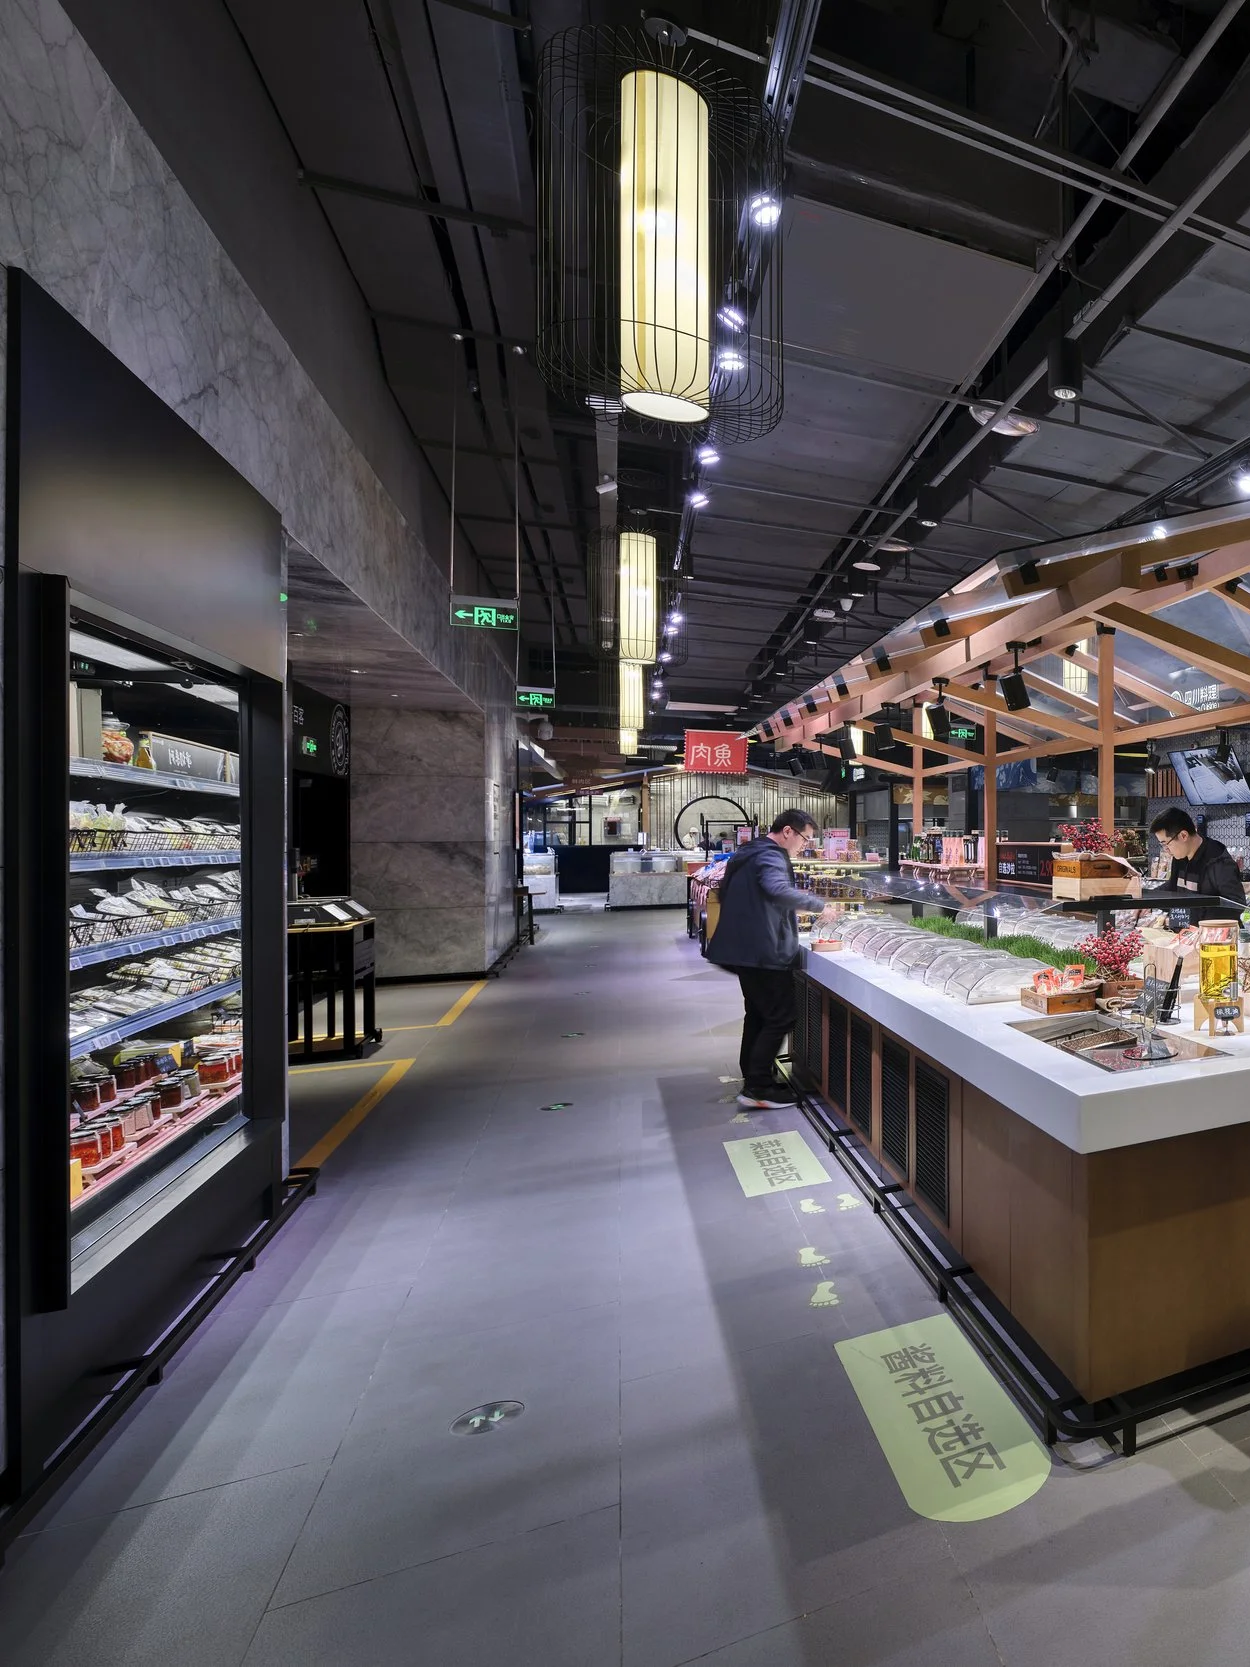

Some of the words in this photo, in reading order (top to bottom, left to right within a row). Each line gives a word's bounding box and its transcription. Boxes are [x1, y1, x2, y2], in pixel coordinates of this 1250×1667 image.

[748, 1138, 804, 1188] 菜品自选区
[880, 1343, 1007, 1488] 酱料自选区
